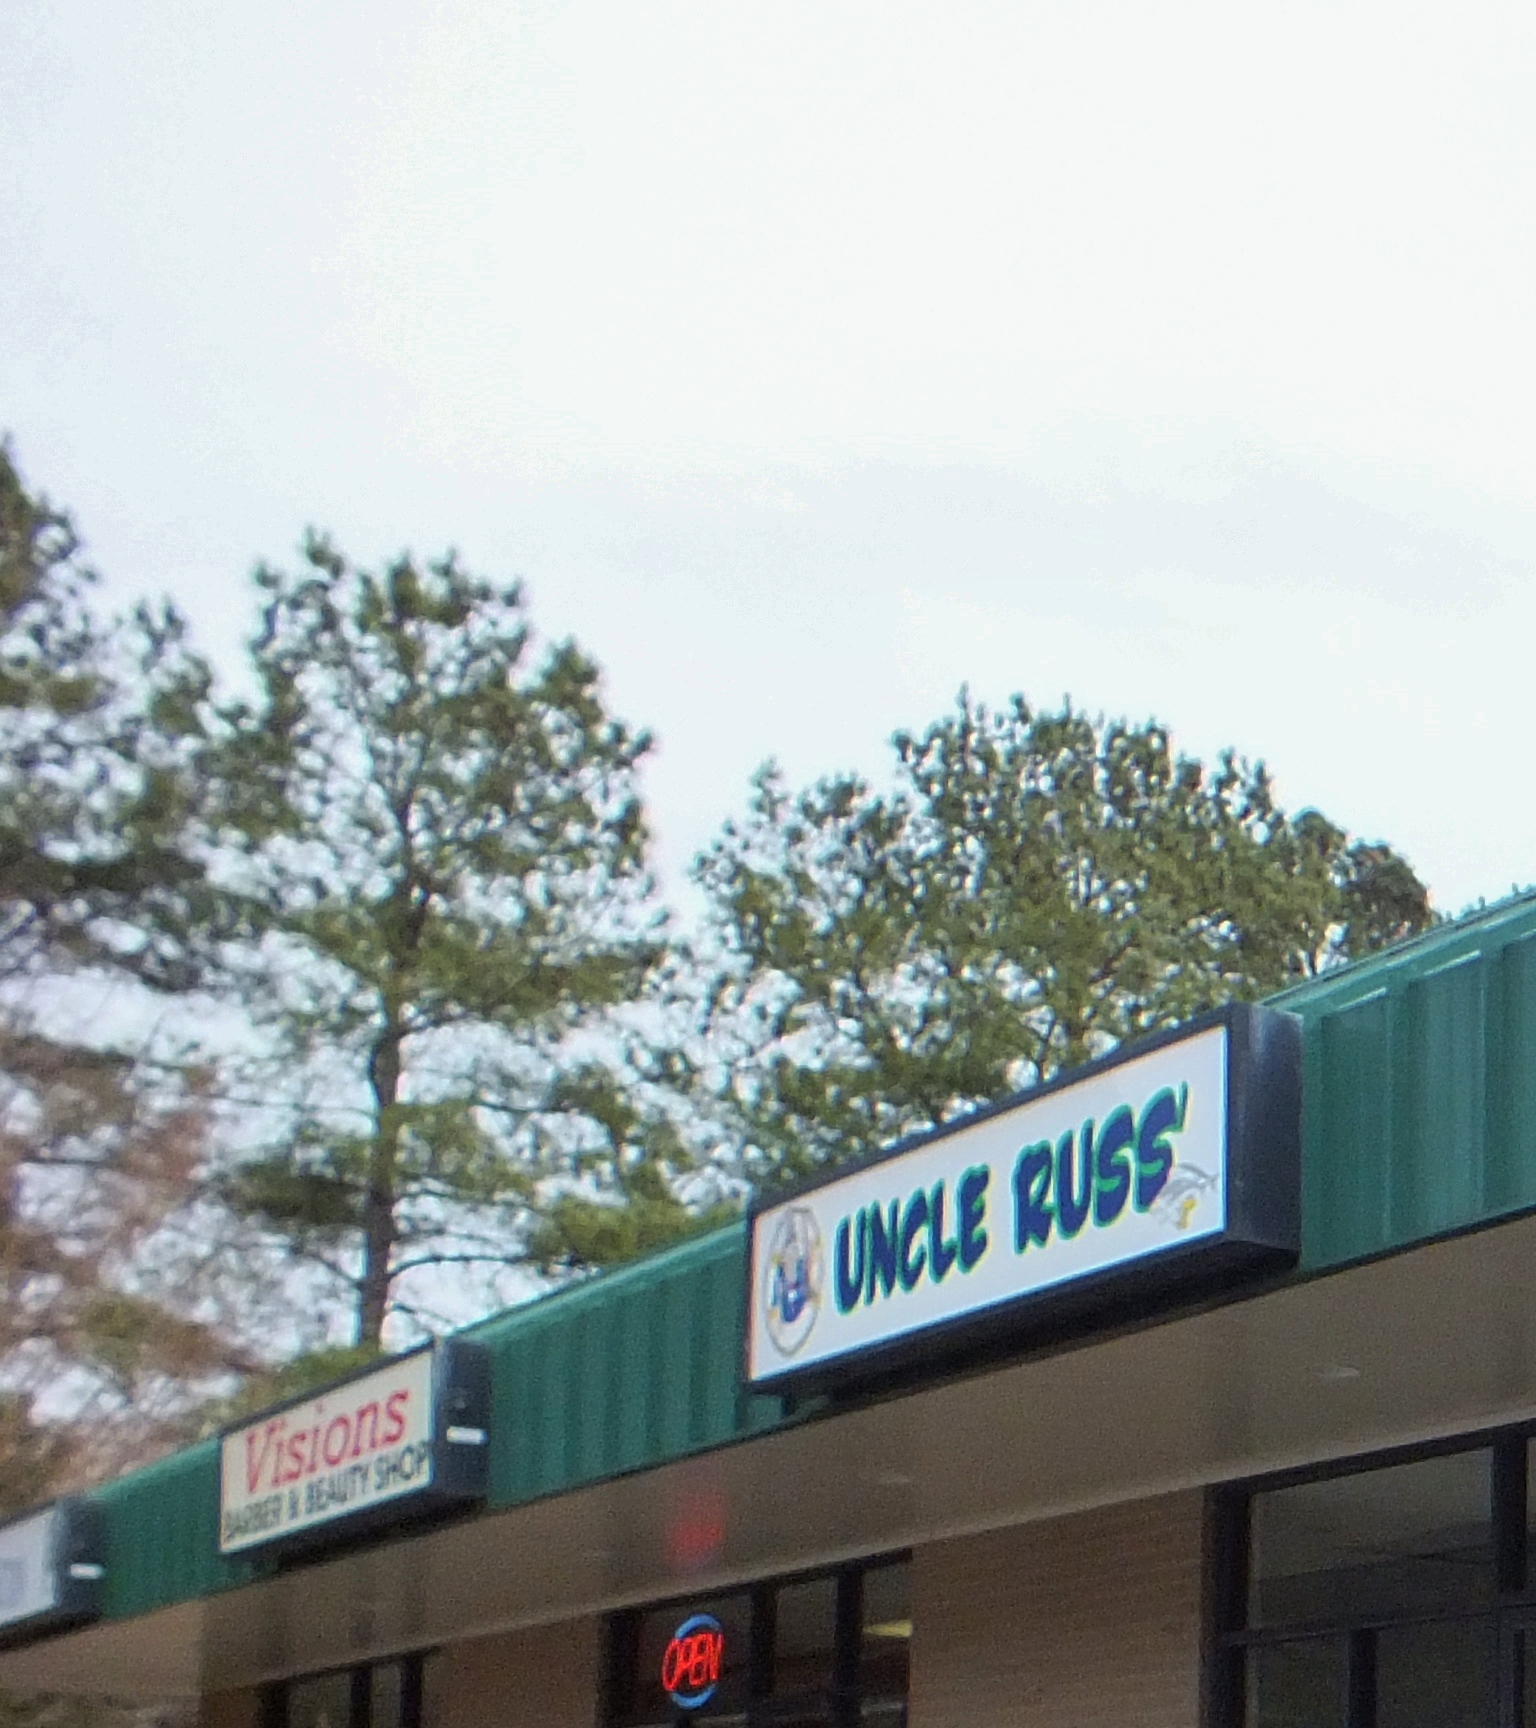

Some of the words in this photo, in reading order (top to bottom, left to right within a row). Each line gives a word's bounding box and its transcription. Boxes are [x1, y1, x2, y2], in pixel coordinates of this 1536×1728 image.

[832, 1163, 990, 1318] UNCLE
[245, 1388, 410, 1494] Visions
[373, 1438, 430, 1491] SHOP
[661, 1631, 726, 1693] OPEN
